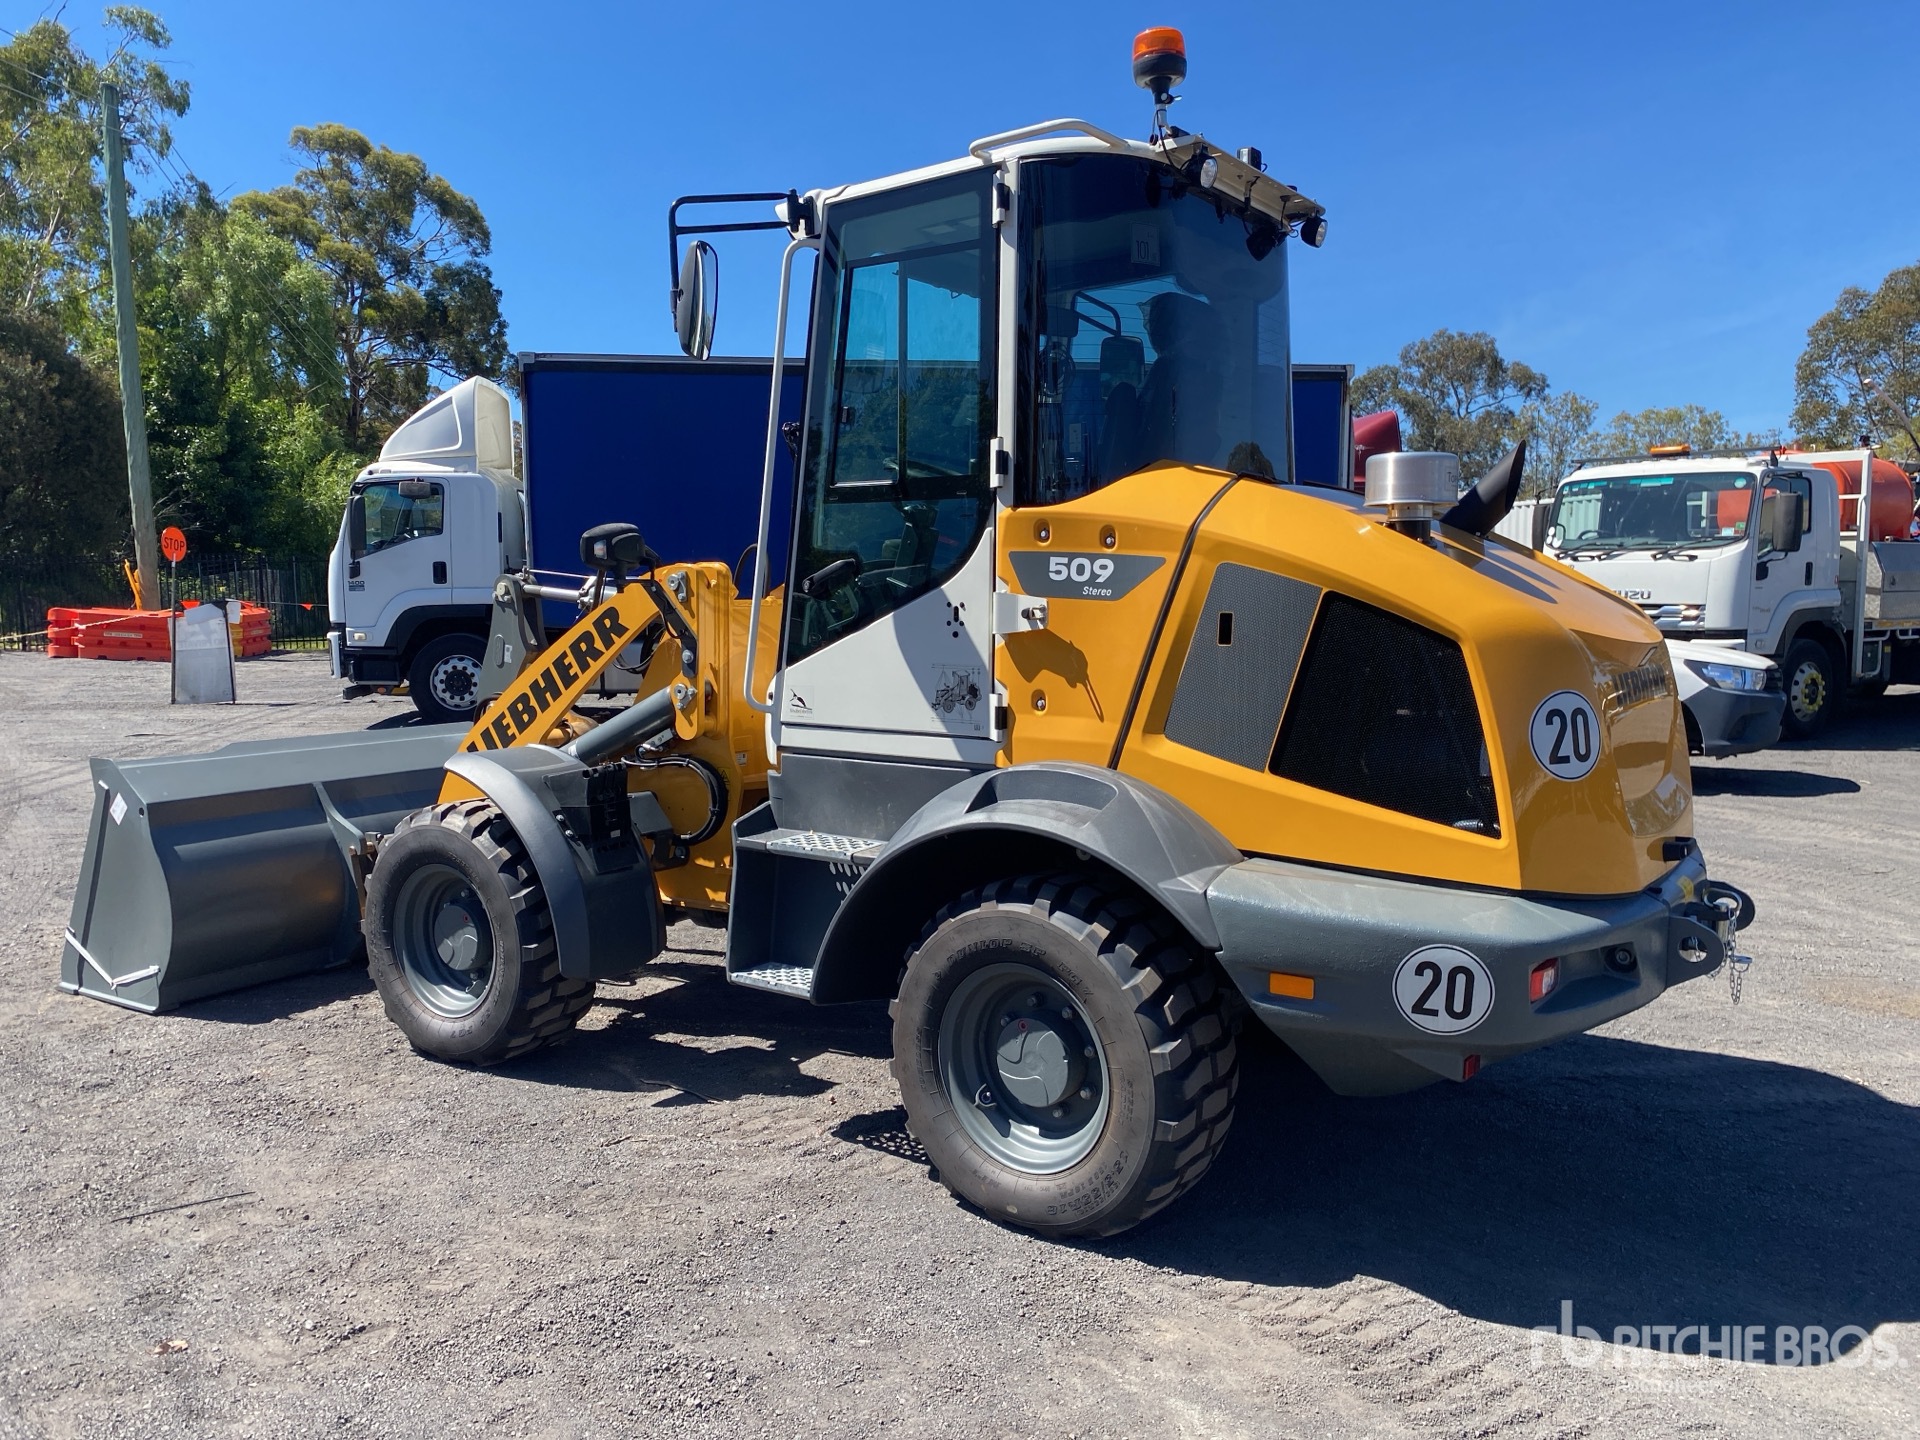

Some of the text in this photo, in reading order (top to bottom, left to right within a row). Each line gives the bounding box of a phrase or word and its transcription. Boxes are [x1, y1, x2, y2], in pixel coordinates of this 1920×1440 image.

[163, 536, 186, 552] STOP
[1048, 556, 1115, 583] 509
[1082, 586, 1112, 597] Stereo
[1613, 589, 1652, 600] UZU
[466, 606, 630, 752] IEBHERR
[1545, 707, 1591, 765] 20
[946, 937, 1013, 963] DUNLOP
[1410, 960, 1475, 1021] 20
